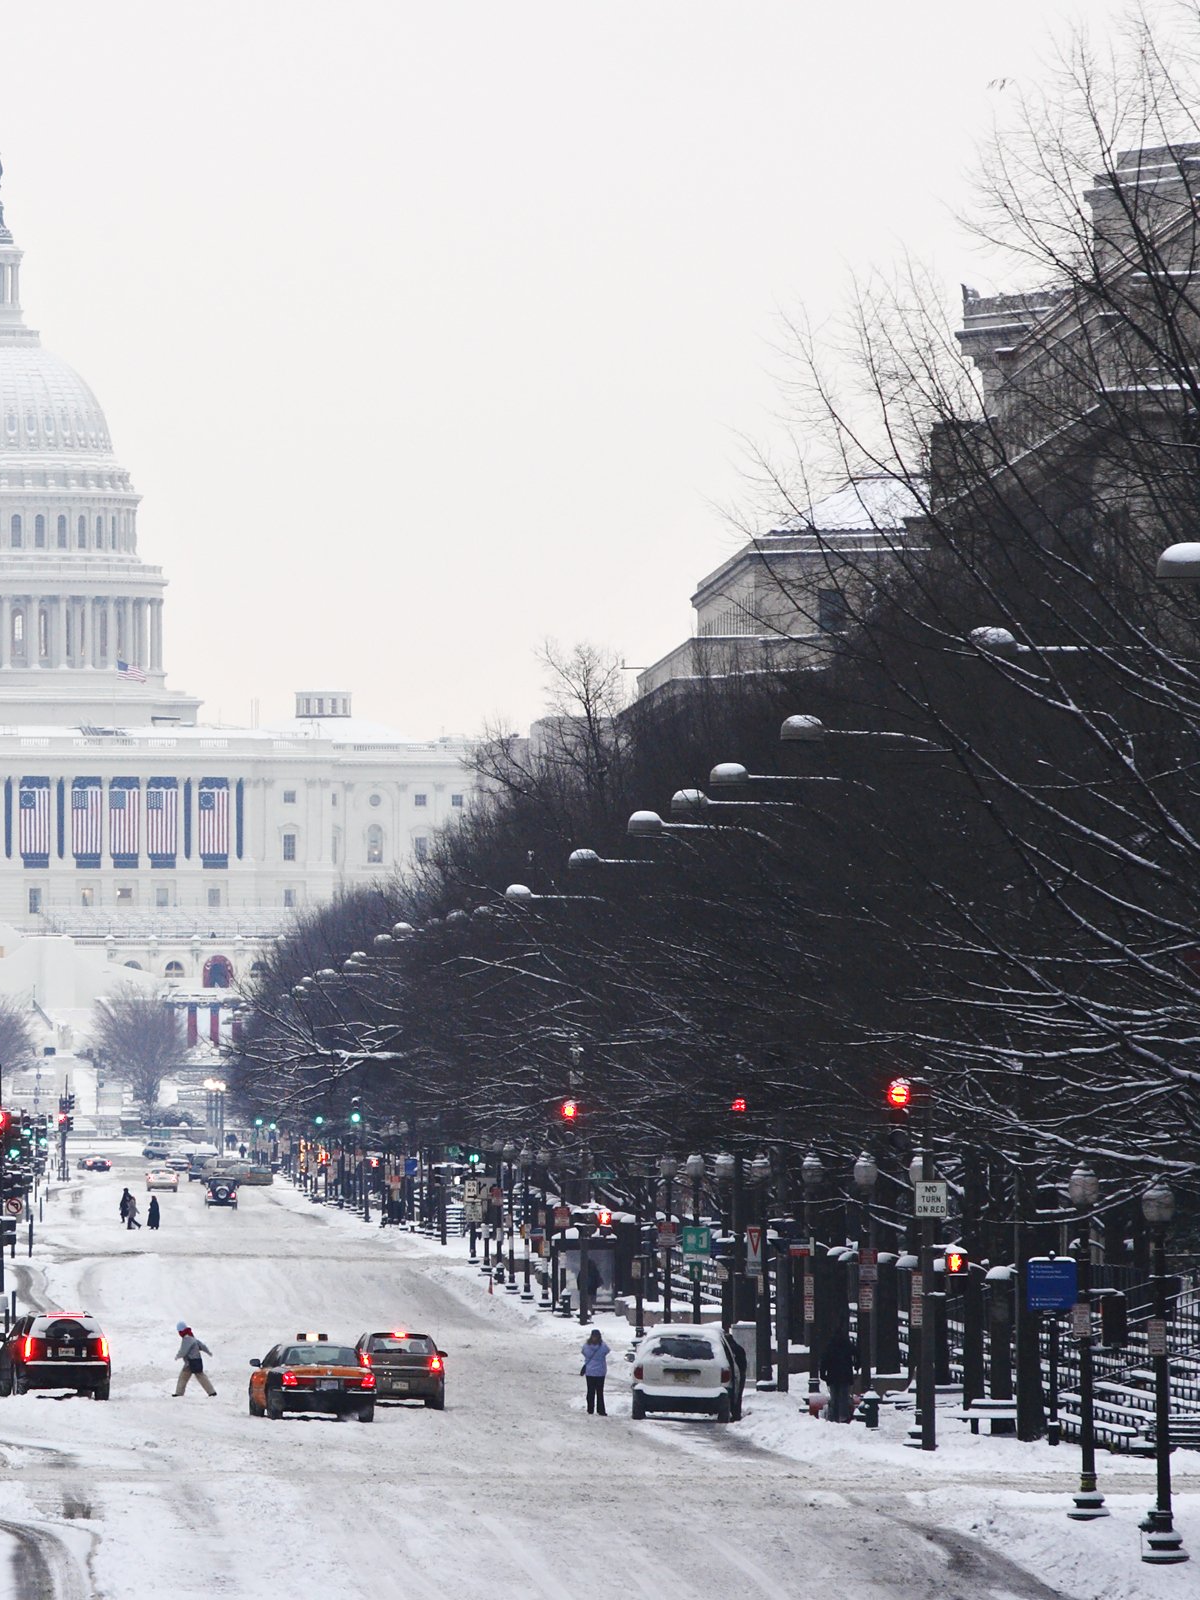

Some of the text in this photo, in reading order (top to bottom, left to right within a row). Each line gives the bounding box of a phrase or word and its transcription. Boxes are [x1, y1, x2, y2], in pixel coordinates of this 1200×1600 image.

[924, 1185, 937, 1193] NO
[921, 1195, 941, 1203] TURN
[917, 1205, 945, 1213] ON RED
